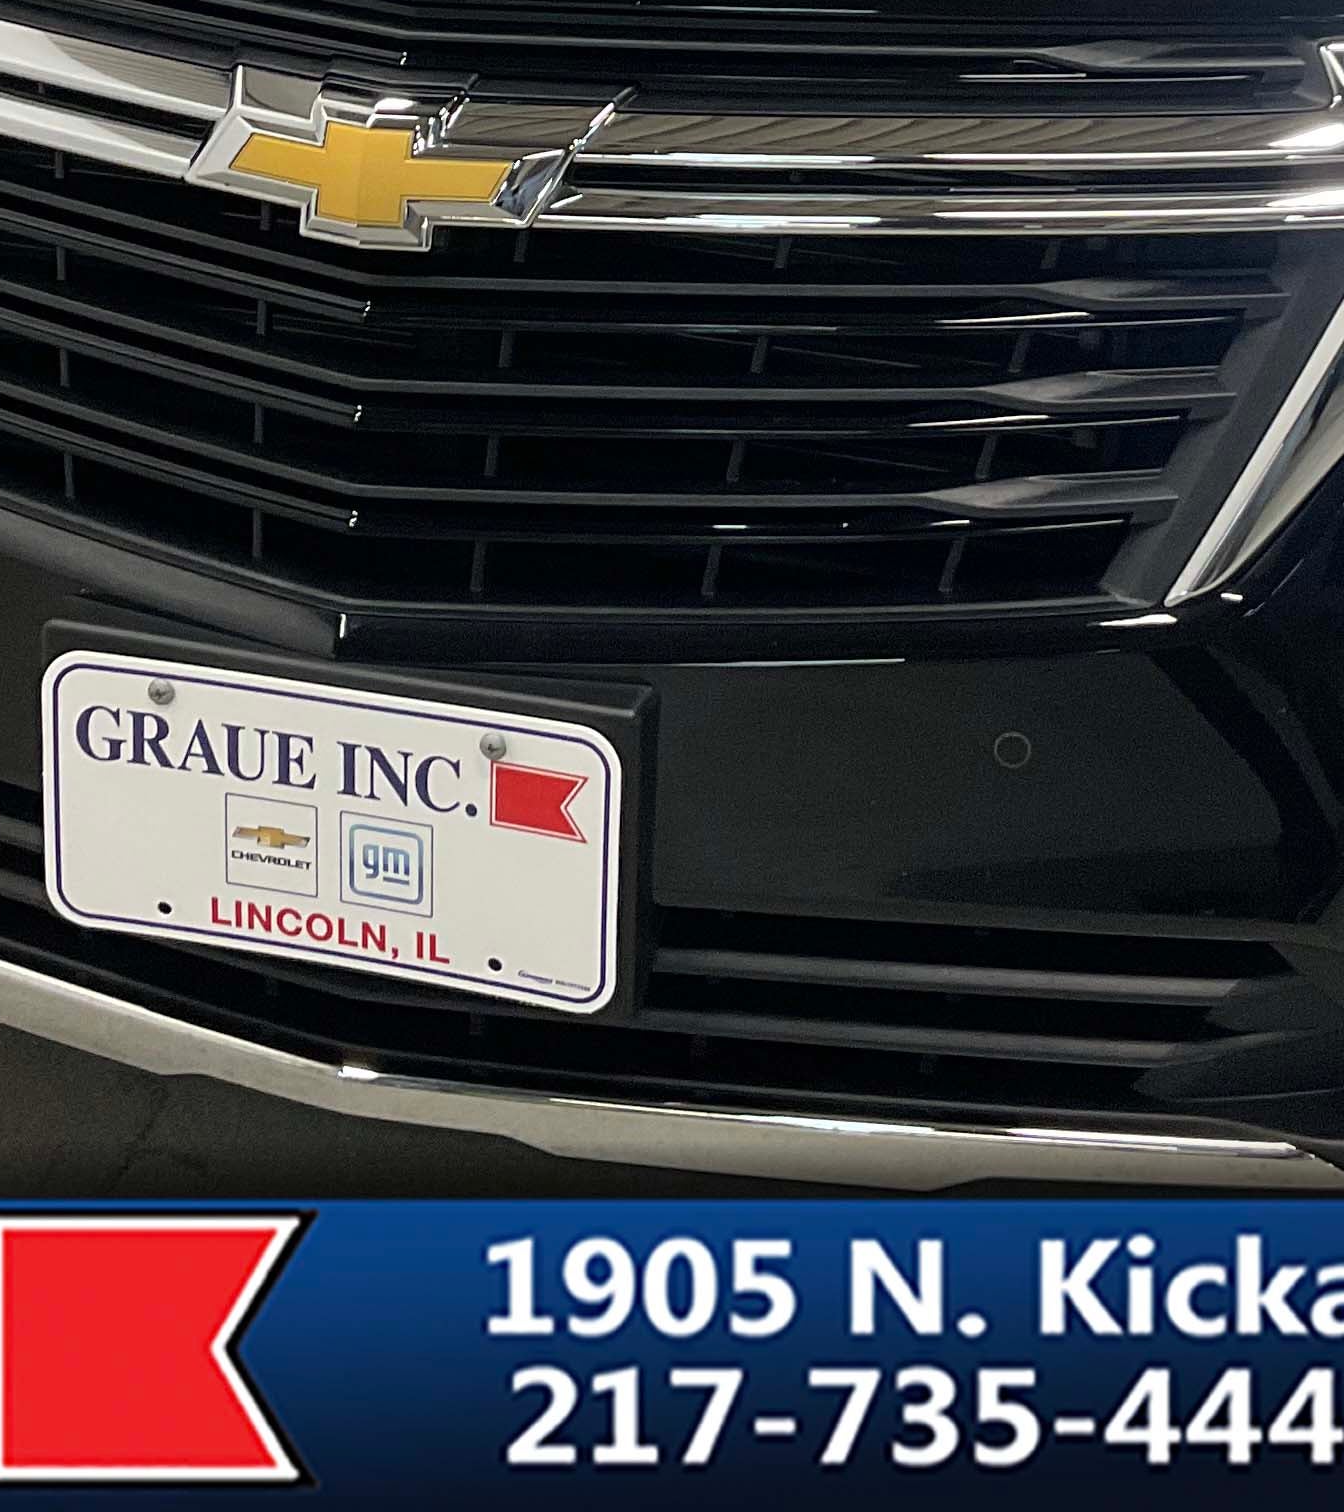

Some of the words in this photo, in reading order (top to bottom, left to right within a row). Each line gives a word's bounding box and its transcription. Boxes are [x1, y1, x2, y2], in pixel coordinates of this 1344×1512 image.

[74, 705, 317, 789] GRAUE
[337, 741, 478, 818] INC.
[231, 849, 312, 871] CHEVROLET
[210, 896, 400, 960] LINCOLN,
[415, 932, 451, 965] IL
